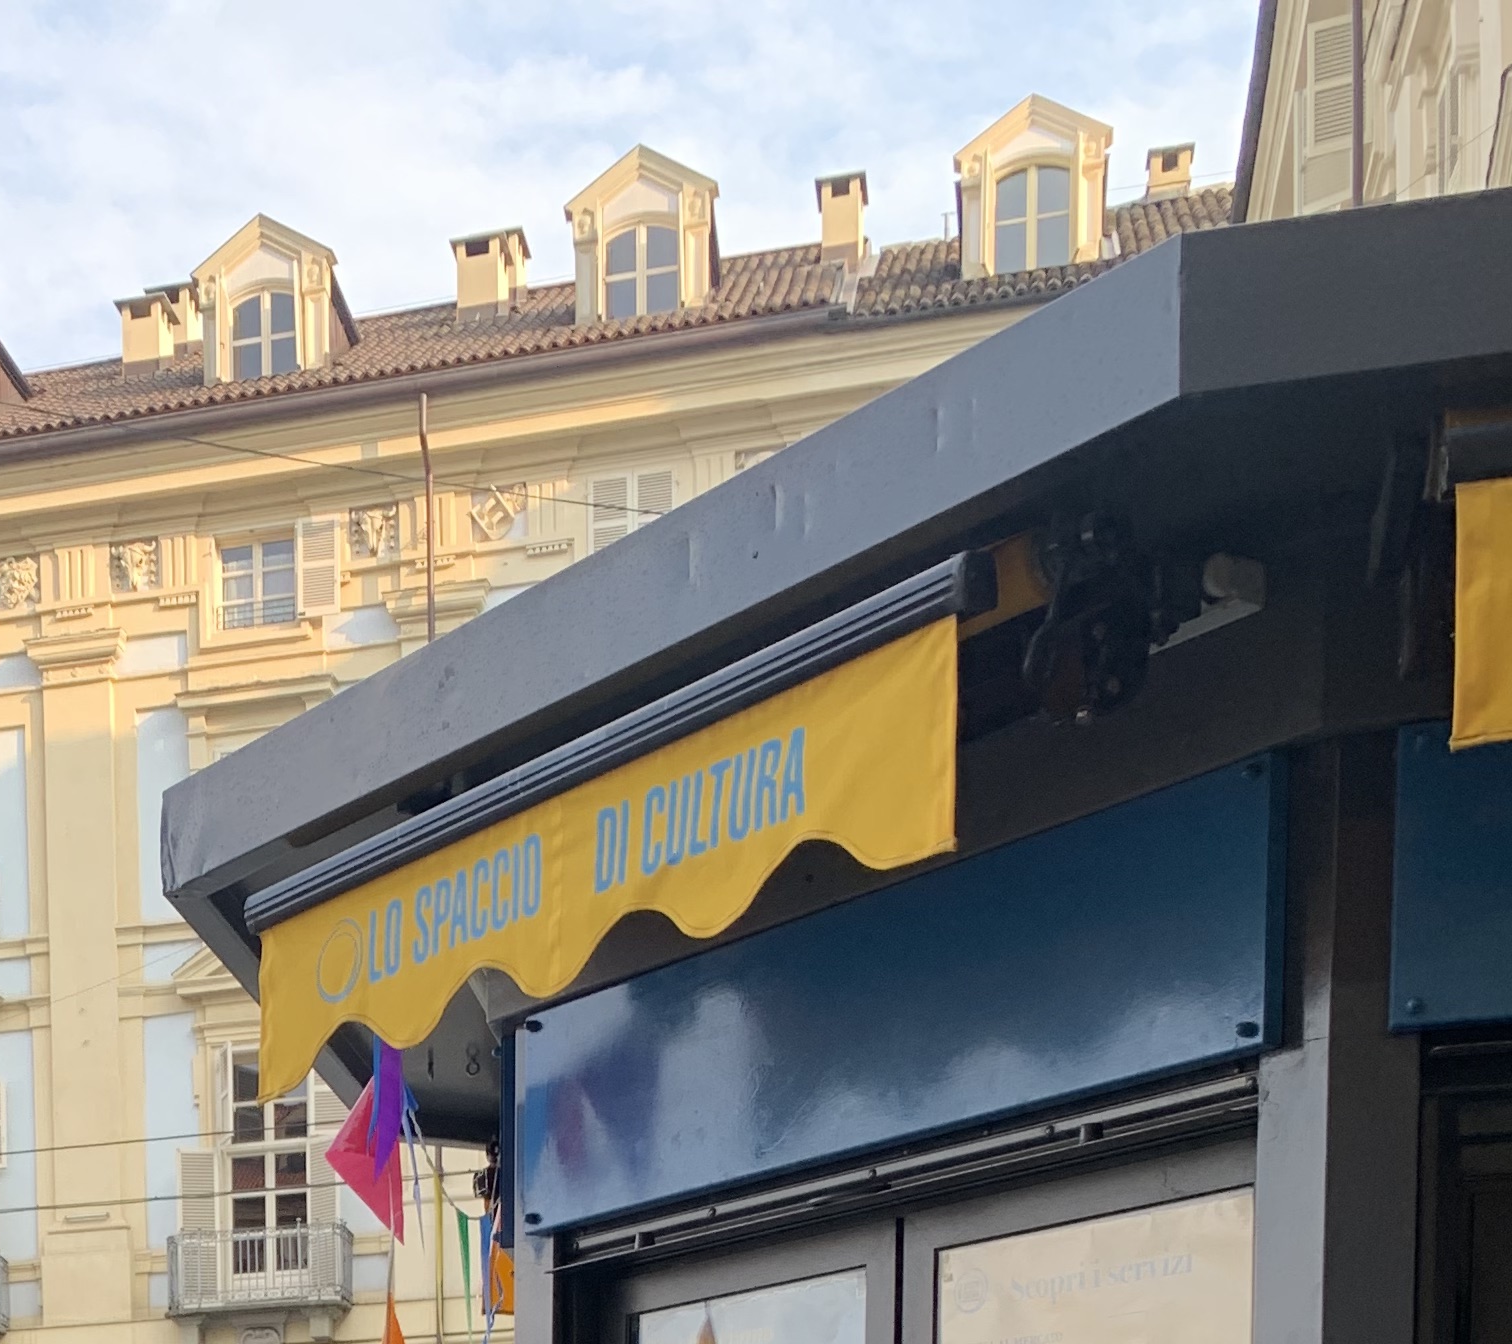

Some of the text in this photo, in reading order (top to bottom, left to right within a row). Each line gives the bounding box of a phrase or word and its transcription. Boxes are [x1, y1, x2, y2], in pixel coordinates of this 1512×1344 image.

[368, 726, 805, 984] LO SPACCIO DI CULTURA
[1011, 1261, 1085, 1304] Scopri
[1093, 1259, 1101, 1288] i
[1110, 1253, 1193, 1284] servizi
